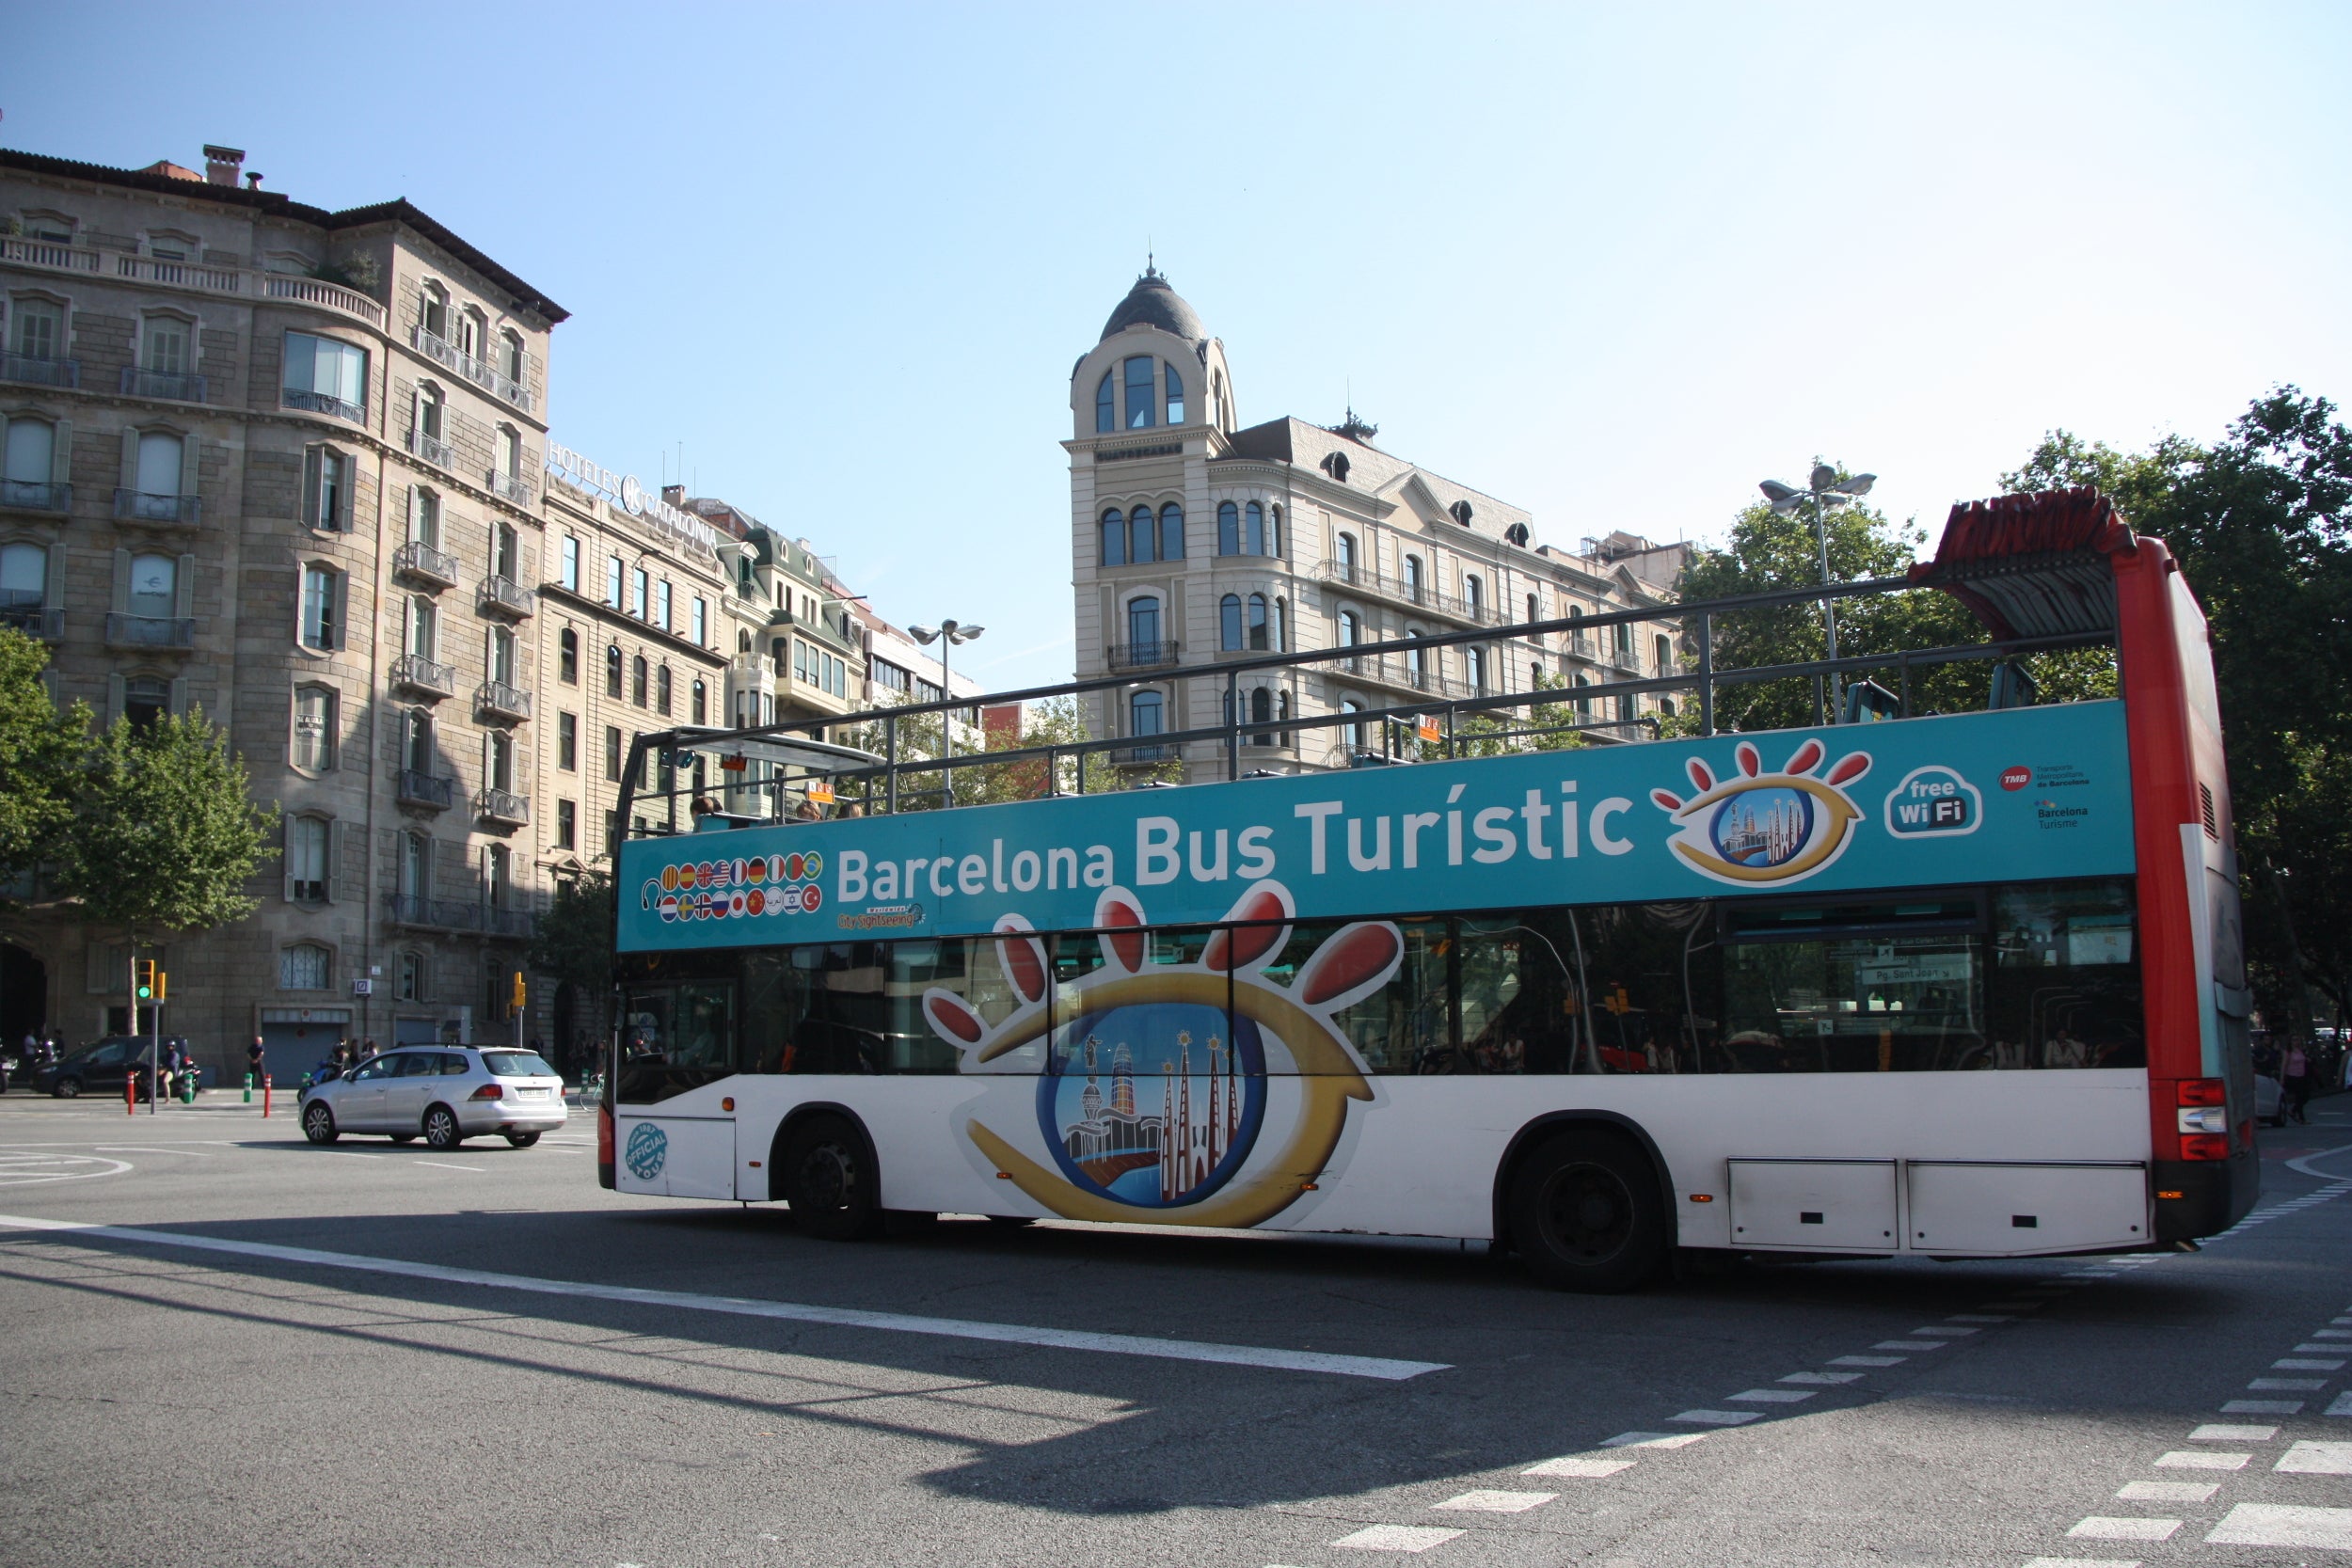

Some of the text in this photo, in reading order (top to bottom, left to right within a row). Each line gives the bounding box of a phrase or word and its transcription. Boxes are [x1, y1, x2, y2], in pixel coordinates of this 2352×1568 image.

[548, 438, 622, 498] HOTELES
[644, 493, 718, 549] CATALONIA
[2004, 774, 2027, 784] TMB
[2049, 779, 2090, 787] Barcelona
[1910, 780, 1955, 798] free
[2038, 807, 2088, 818] Barcelona
[2038, 818, 2078, 830] Turisme
[837, 780, 1634, 903] Barcelona Bus Turístic
[838, 912, 914, 930] City Sightseeing
[1893, 970, 1914, 978] Sant
[627, 1134, 666, 1165] OFFICIAL
[637, 1151, 664, 1178] TOUR
